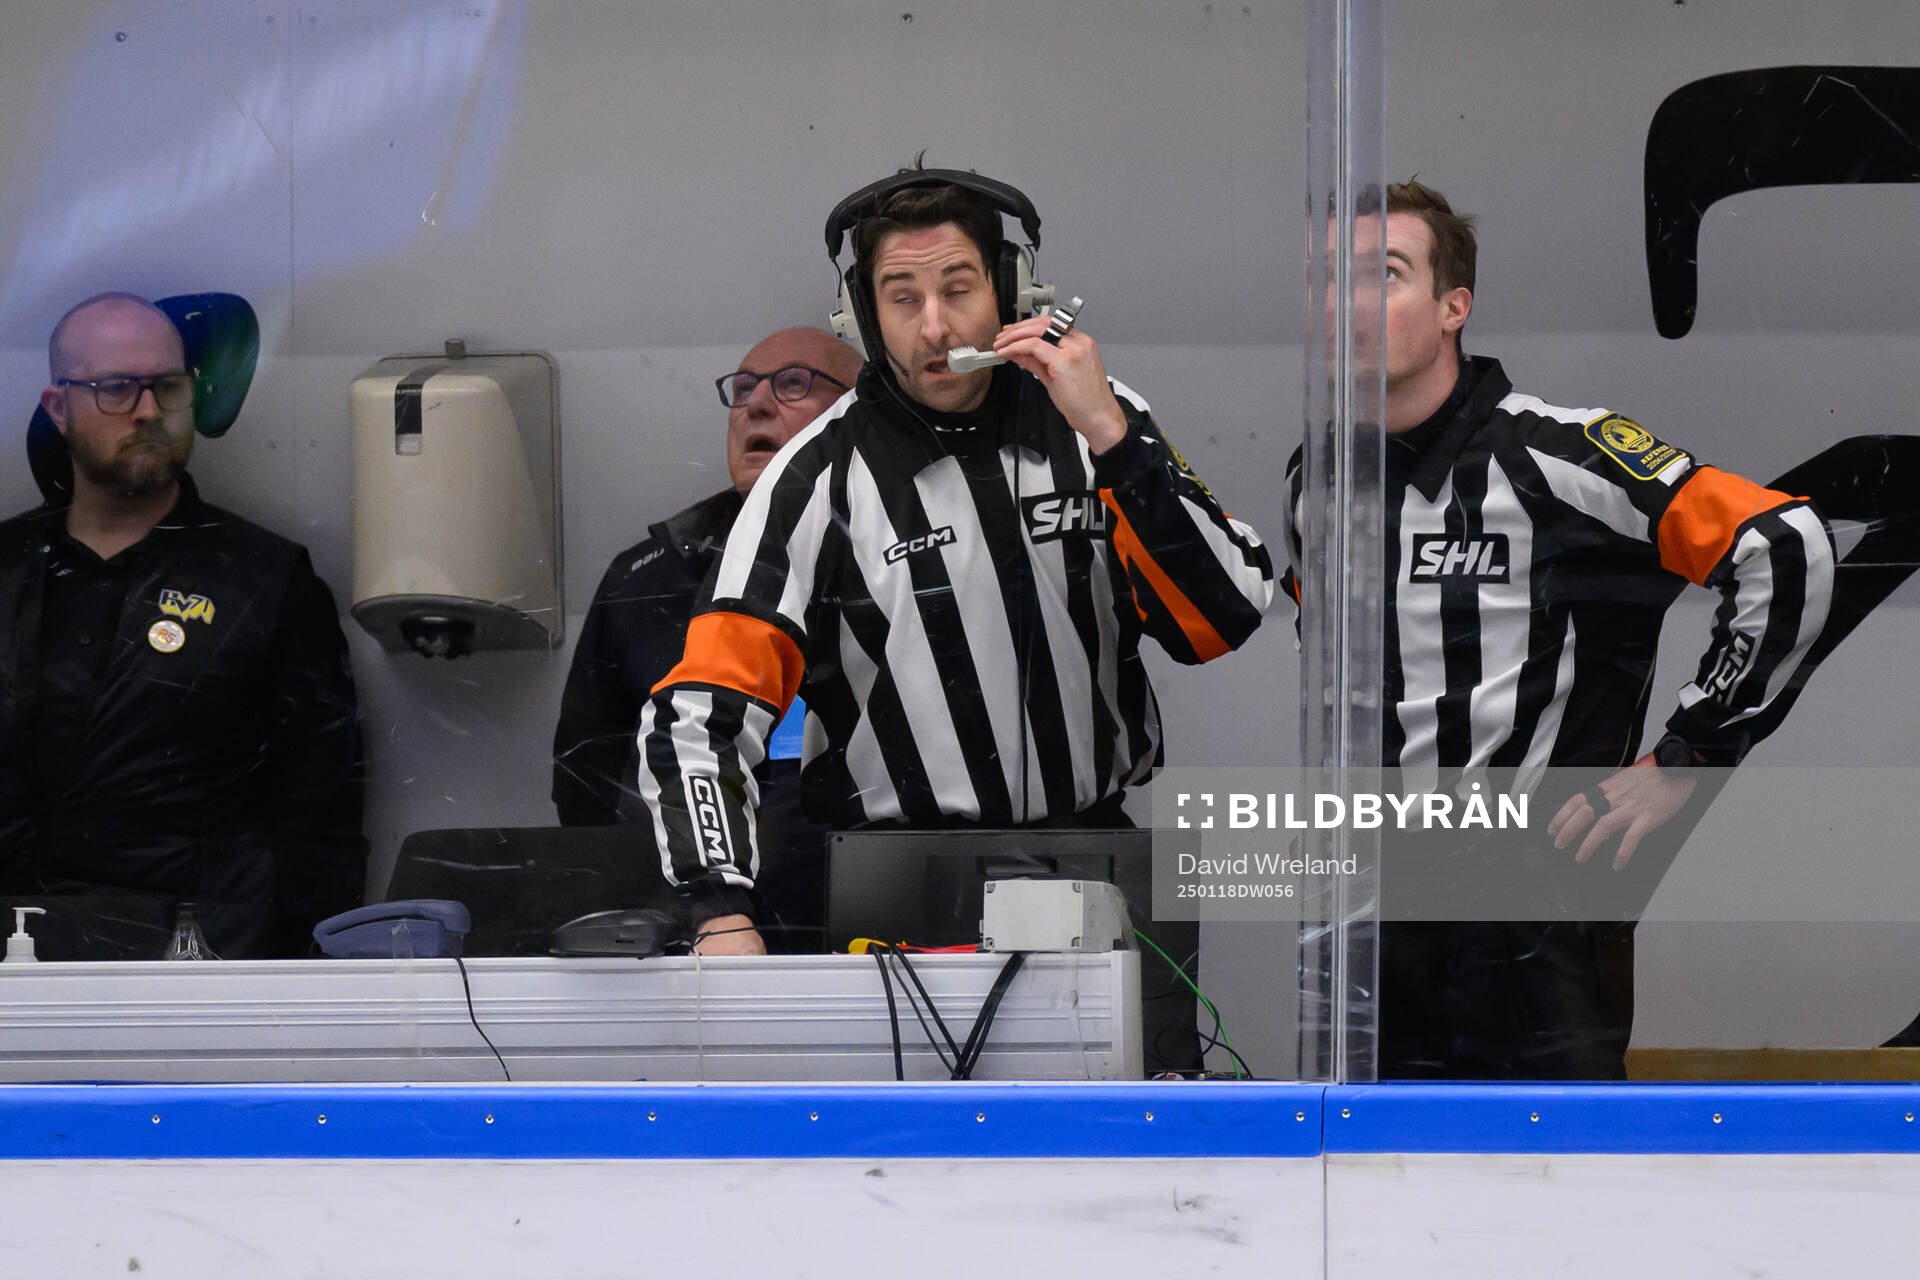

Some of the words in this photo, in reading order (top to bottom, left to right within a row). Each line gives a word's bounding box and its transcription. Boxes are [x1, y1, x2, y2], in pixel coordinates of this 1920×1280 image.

[1030, 498, 1107, 537] SHL
[888, 528, 952, 562] CCM
[1413, 541, 1507, 576] SHL
[693, 777, 728, 861] CCM
